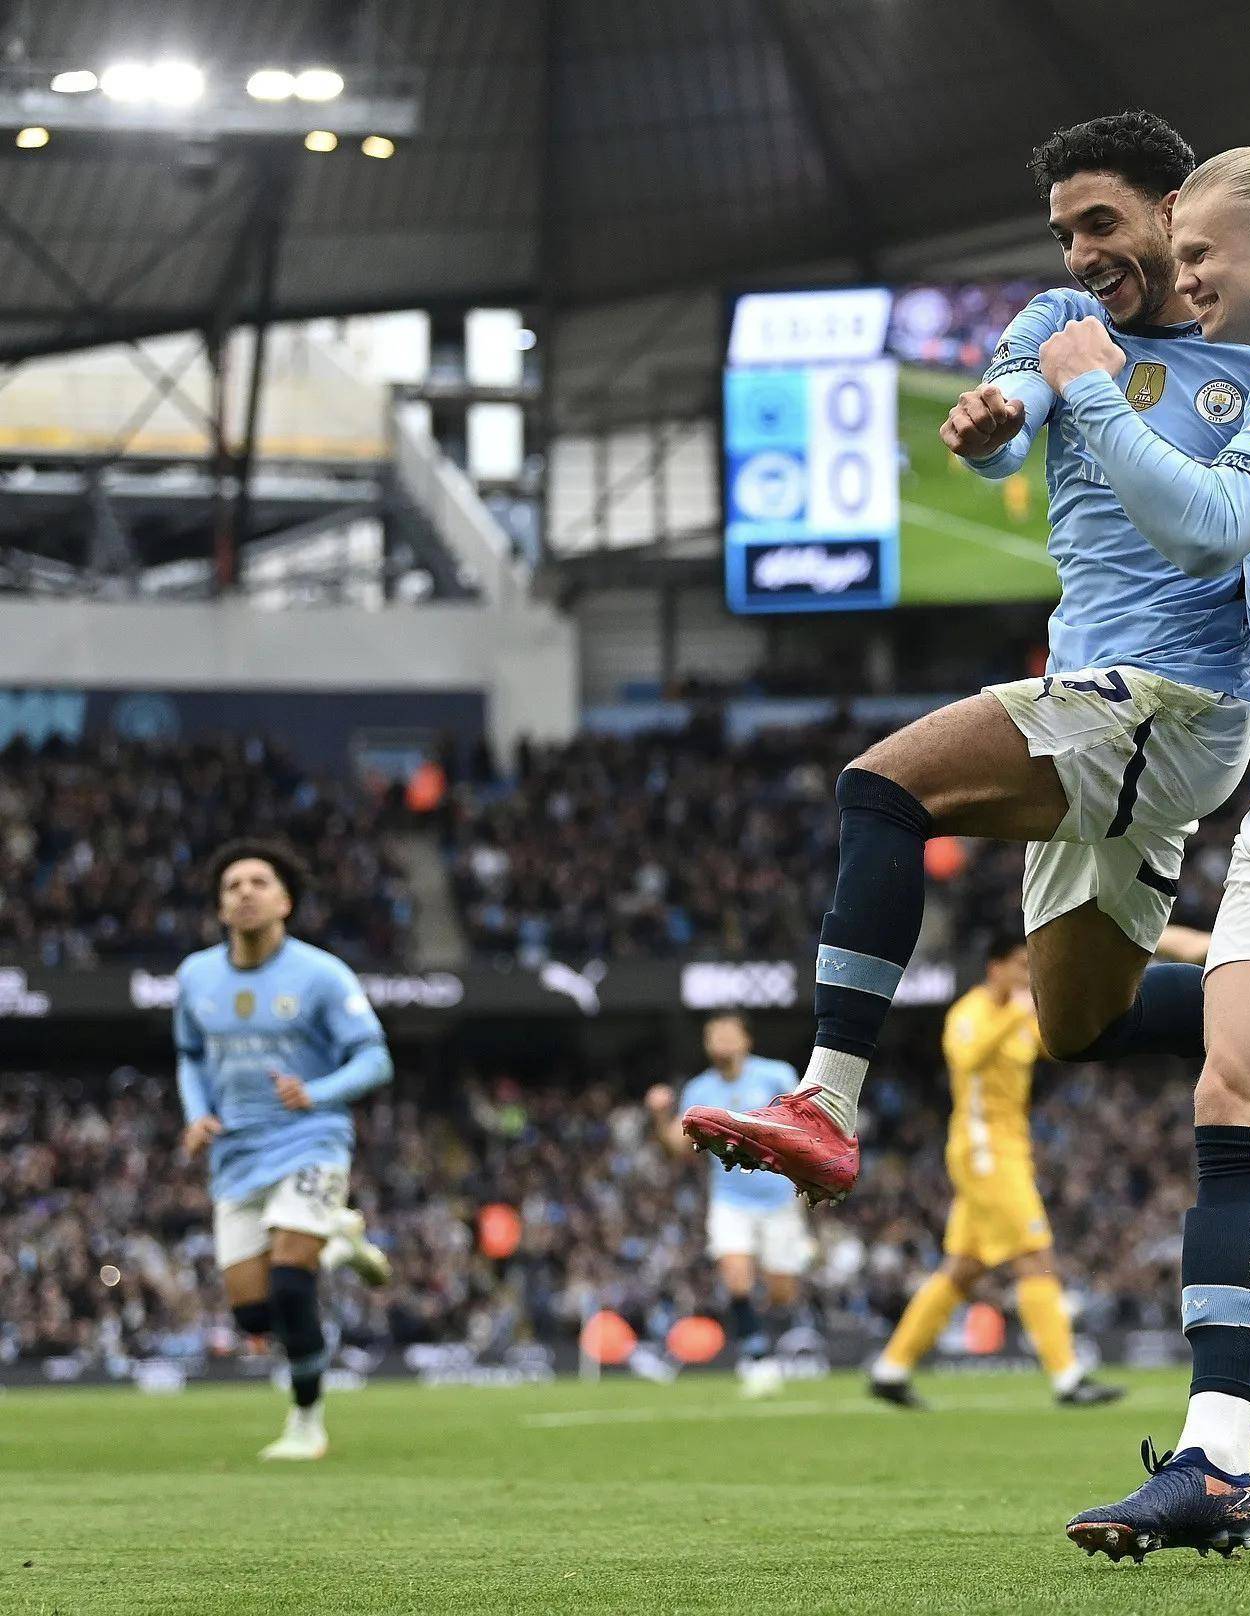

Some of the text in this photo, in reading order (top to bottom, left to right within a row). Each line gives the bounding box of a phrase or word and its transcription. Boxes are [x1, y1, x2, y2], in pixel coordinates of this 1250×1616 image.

[1133, 394, 1152, 402] FIFA
[1202, 382, 1240, 400] MANCHESTER
[825, 377, 873, 437] 0
[1207, 415, 1223, 423] CITY
[827, 452, 873, 517] 0
